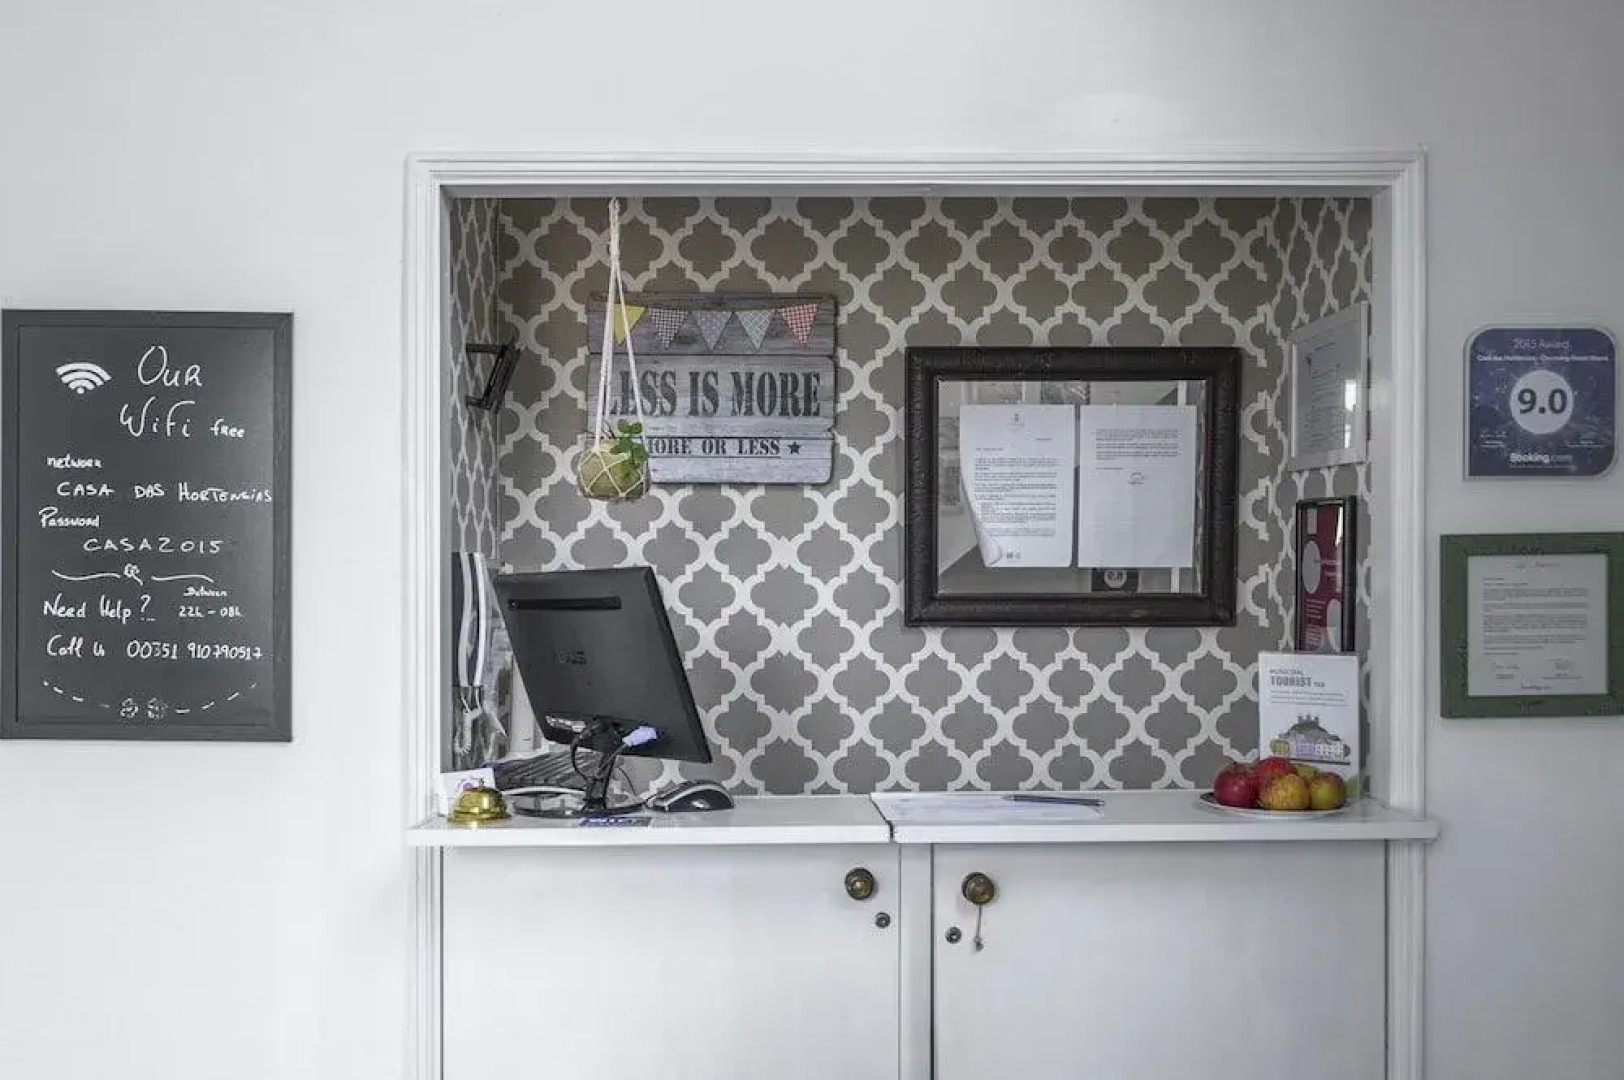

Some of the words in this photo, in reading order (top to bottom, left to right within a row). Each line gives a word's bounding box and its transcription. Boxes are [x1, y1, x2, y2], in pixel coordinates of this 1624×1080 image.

[688, 371, 719, 416] IS
[731, 371, 821, 417] MORE
[1517, 387, 1568, 414] 9.0
[702, 437, 727, 455] OR
[738, 437, 781, 456] LESS
[56, 481, 115, 497] CASA
[134, 483, 165, 499] DAS
[43, 593, 86, 619] Need
[1270, 676, 1312, 688] TOURIST
